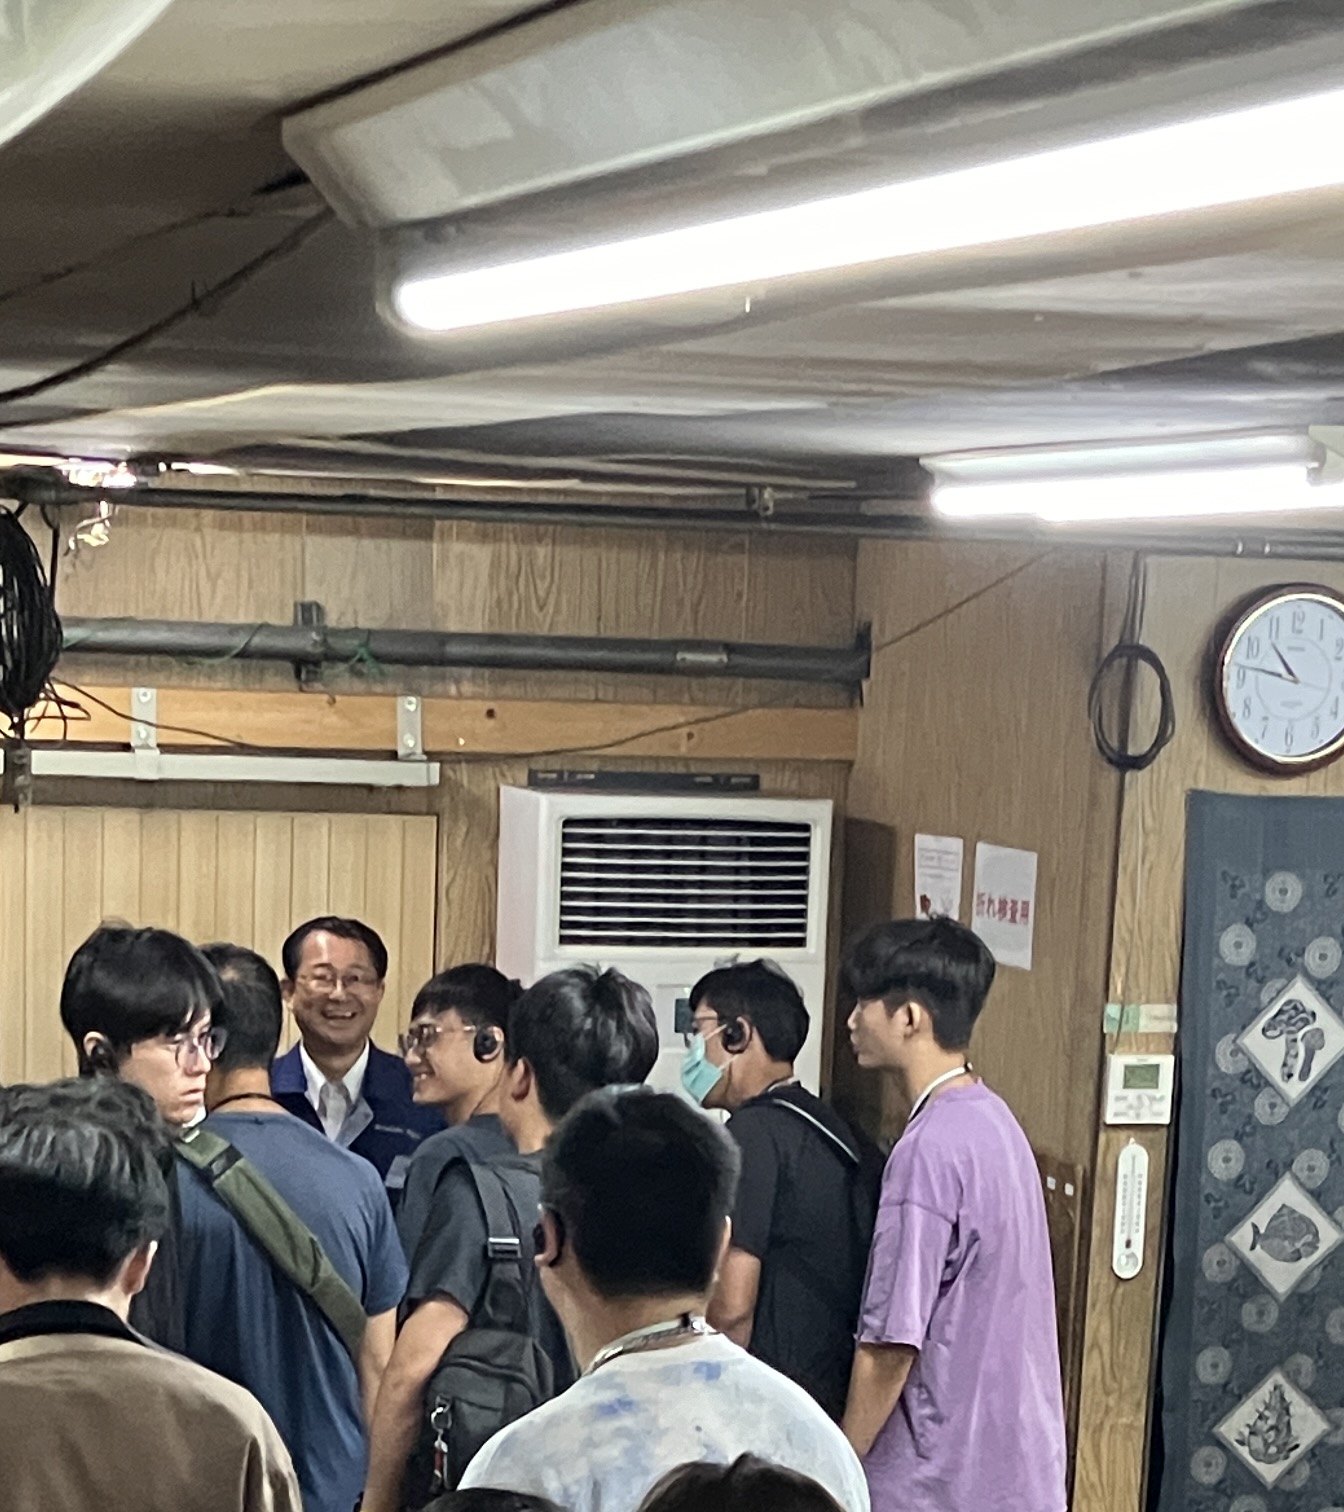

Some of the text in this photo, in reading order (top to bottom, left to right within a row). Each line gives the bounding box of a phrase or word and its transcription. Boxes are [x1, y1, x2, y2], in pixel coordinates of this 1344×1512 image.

[1268, 615, 1280, 640] 11
[1292, 611, 1305, 634] 12
[1319, 618, 1324, 641] 1
[1246, 636, 1260, 660] 10
[1334, 638, 1344, 660] 2
[1236, 667, 1246, 690] 9
[1242, 696, 1252, 719] 8
[1330, 696, 1339, 720] 4
[1261, 716, 1269, 739] 7
[1284, 719, 1294, 747] 6
[1311, 716, 1320, 740] 5
